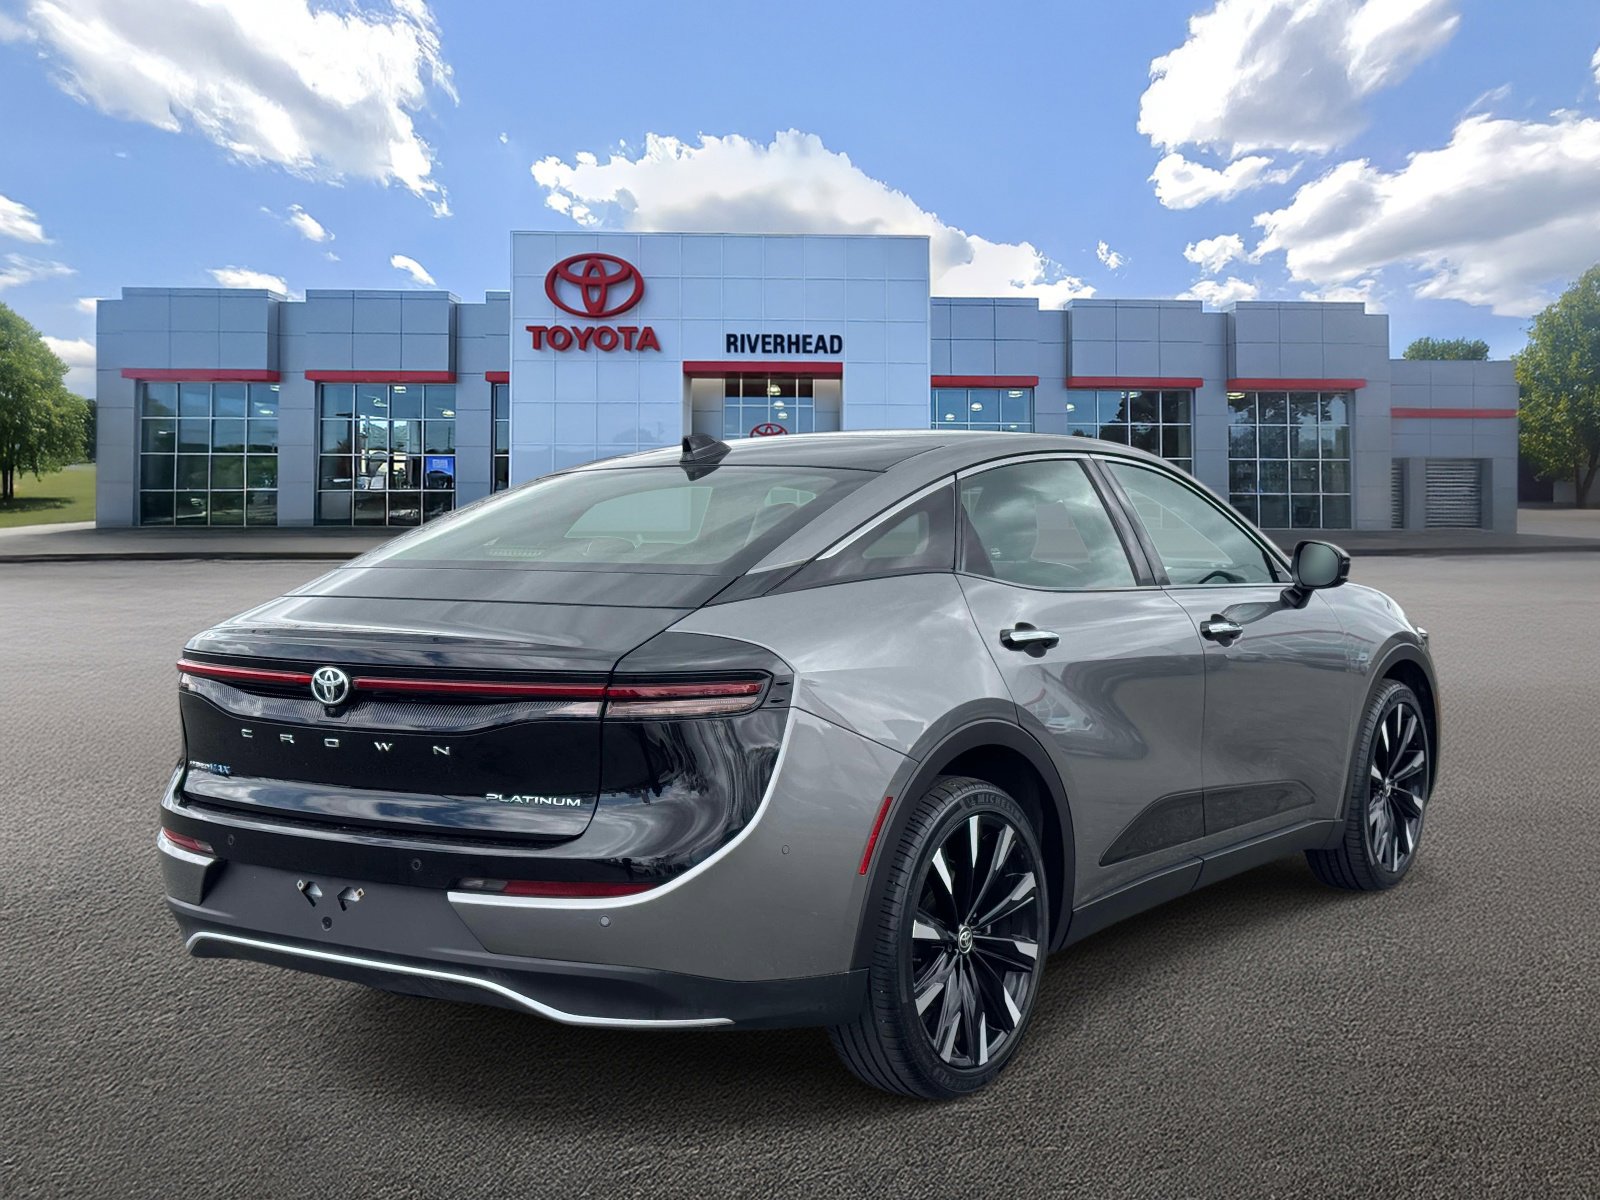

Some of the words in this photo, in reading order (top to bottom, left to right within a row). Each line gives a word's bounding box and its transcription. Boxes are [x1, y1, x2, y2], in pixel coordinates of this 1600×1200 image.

[526, 325, 660, 351] TOYOTA
[726, 333, 843, 354] RIVERHEAD
[241, 728, 450, 755] CROWN
[486, 793, 581, 807] PLATINUM
